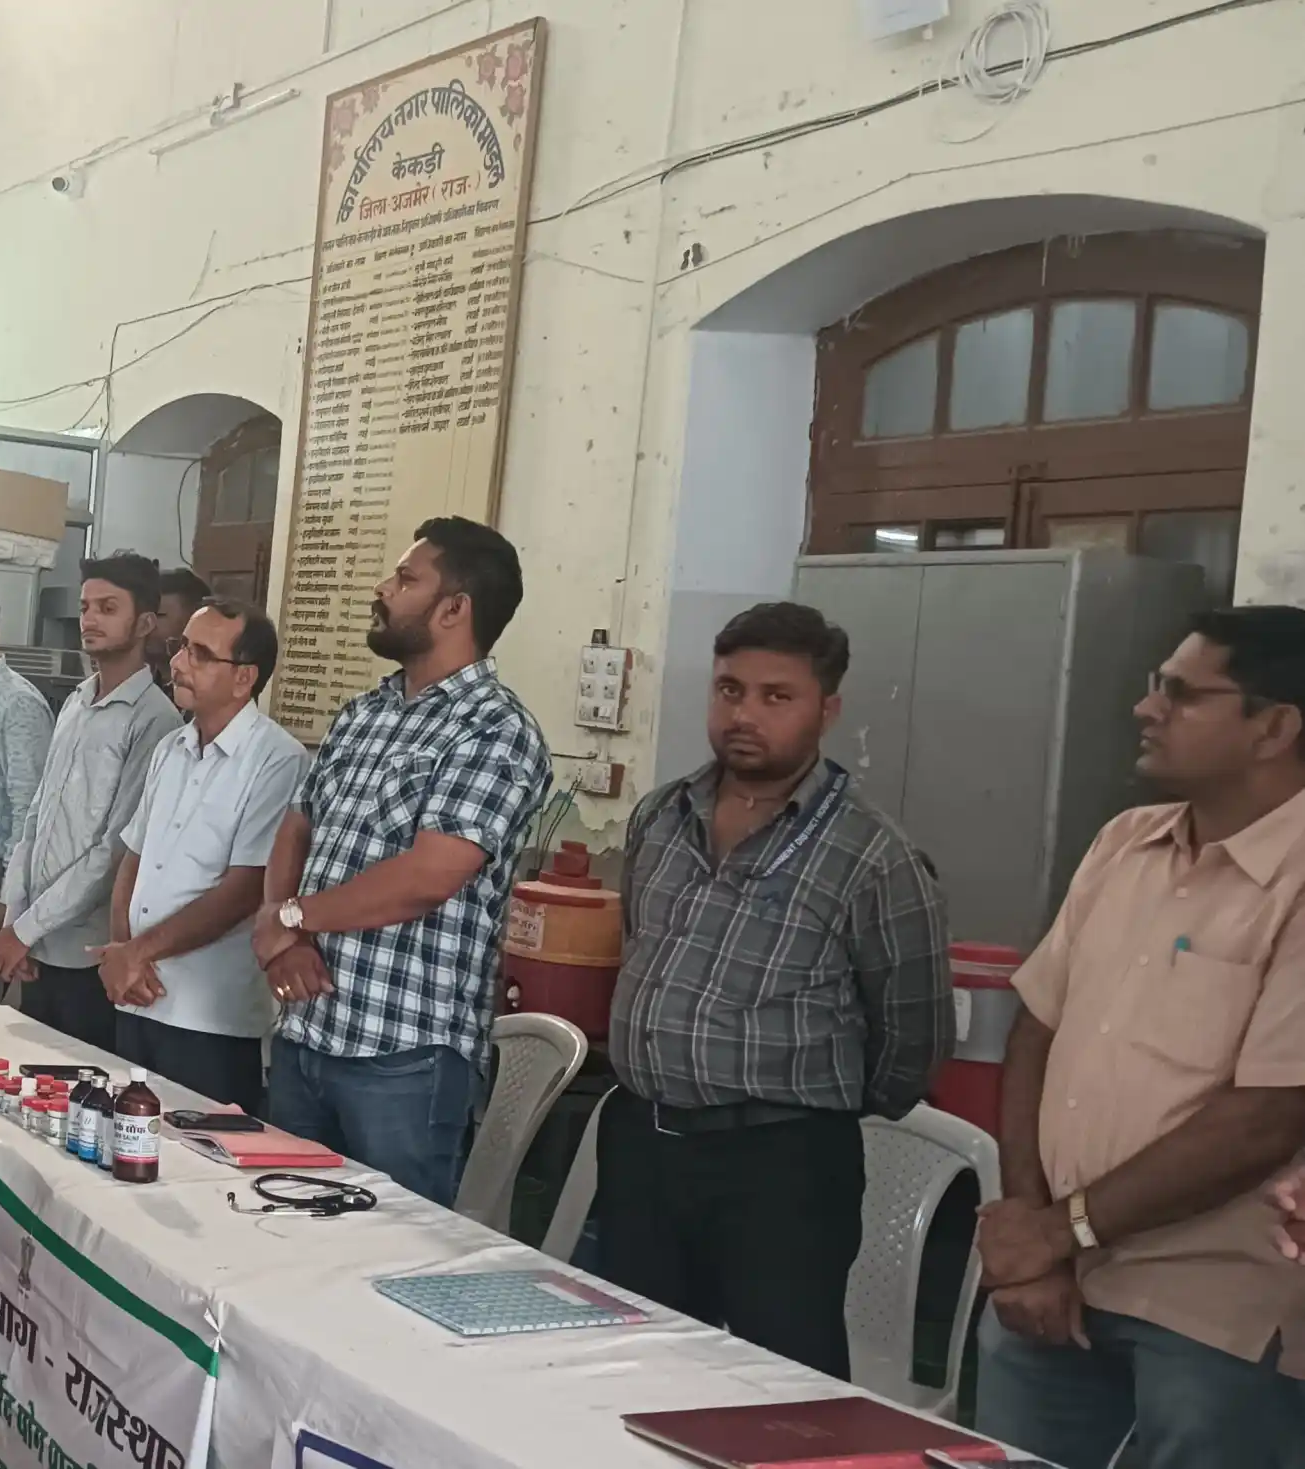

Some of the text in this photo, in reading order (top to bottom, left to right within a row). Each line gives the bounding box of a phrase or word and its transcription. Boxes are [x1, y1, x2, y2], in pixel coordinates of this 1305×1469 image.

[336, 113, 395, 224] कार्यालय
[394, 89, 429, 126] नगर
[430, 79, 486, 137] पालिका
[391, 142, 446, 181] केकड़ी
